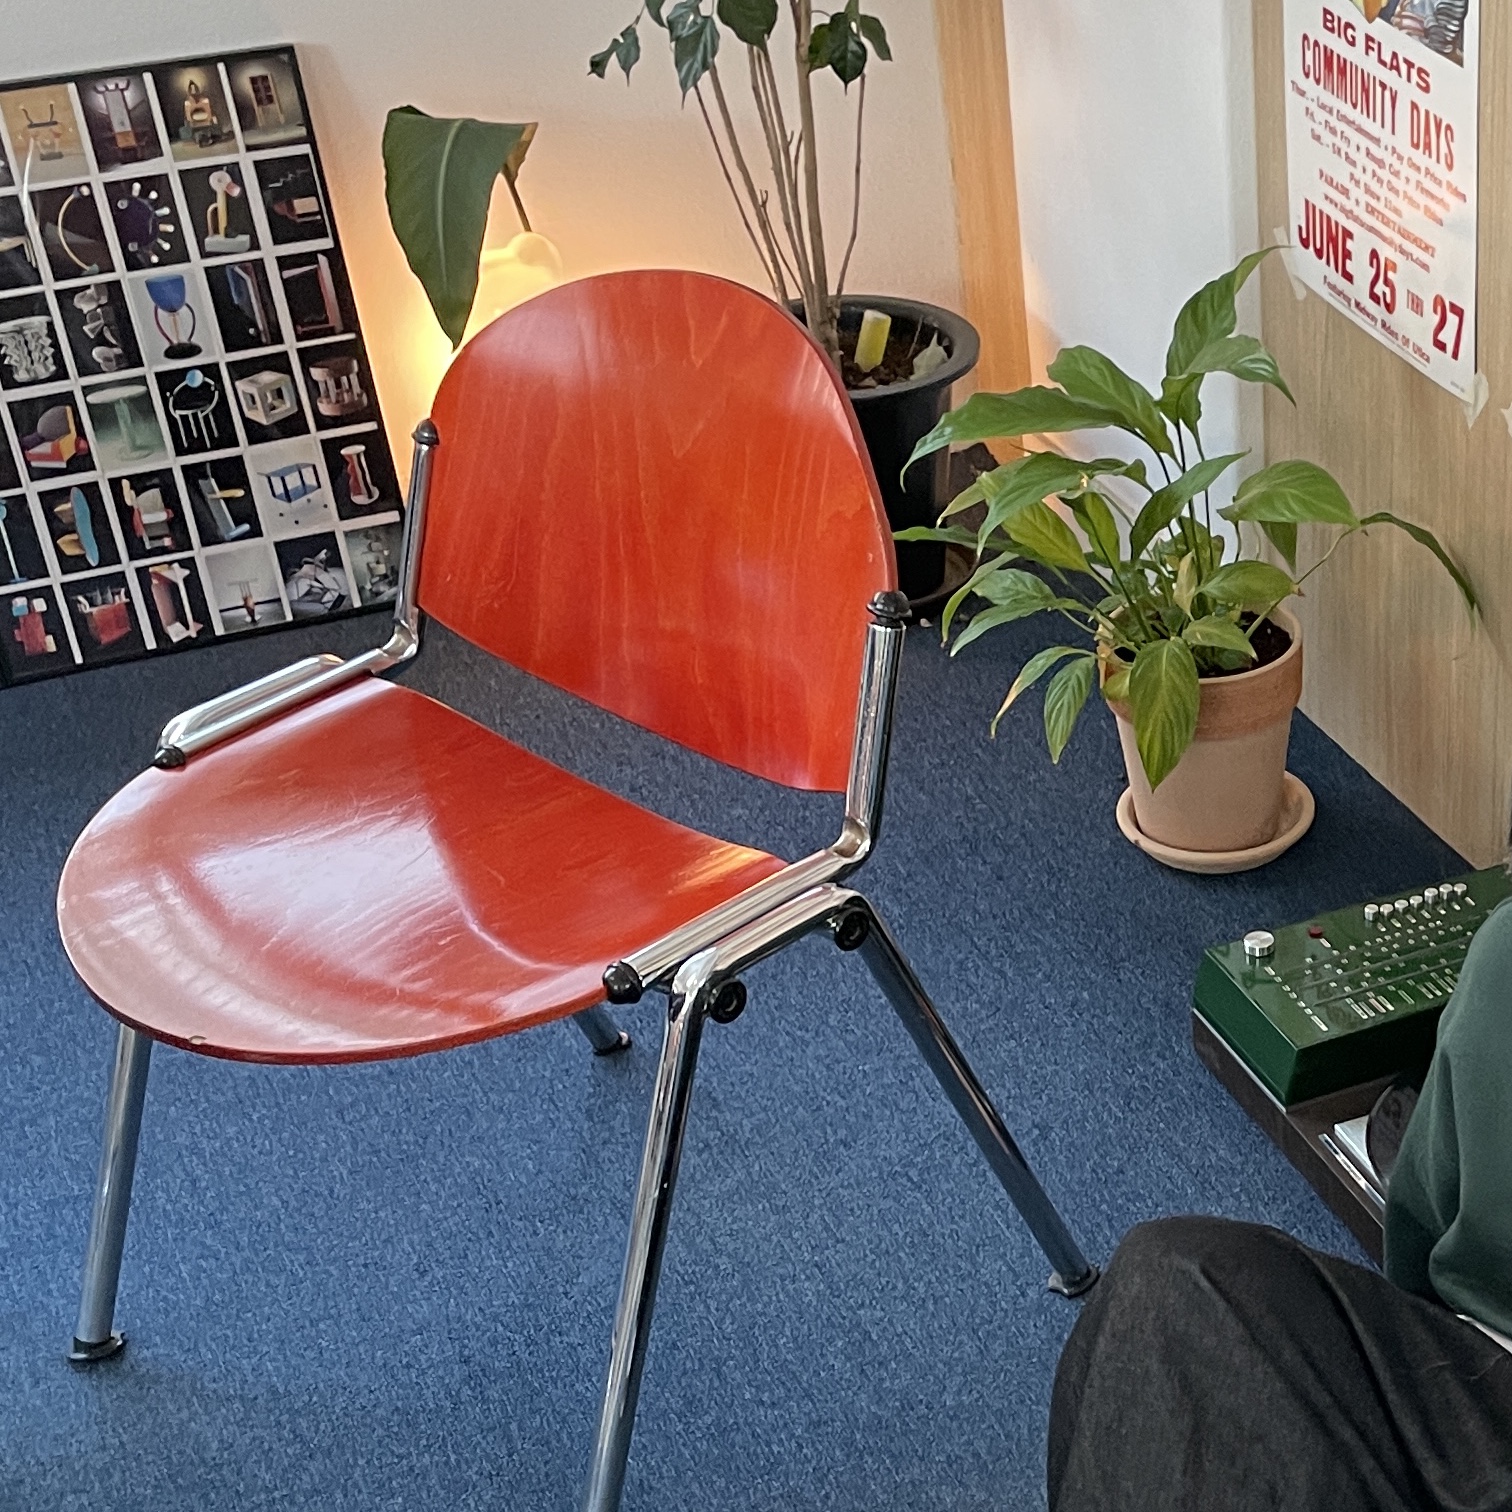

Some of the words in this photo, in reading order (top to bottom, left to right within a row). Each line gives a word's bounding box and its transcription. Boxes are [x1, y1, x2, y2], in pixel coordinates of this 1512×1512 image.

[1302, 33, 1398, 136] COMMUNITY
[1410, 99, 1454, 172] DAYS
[1323, 7, 1356, 47] BIG
[1365, 33, 1430, 94] FLATS
[1298, 198, 1354, 285] JUNE
[1368, 248, 1398, 315] 25
[1407, 289, 1424, 317] THRU
[1432, 293, 1465, 361] 27
